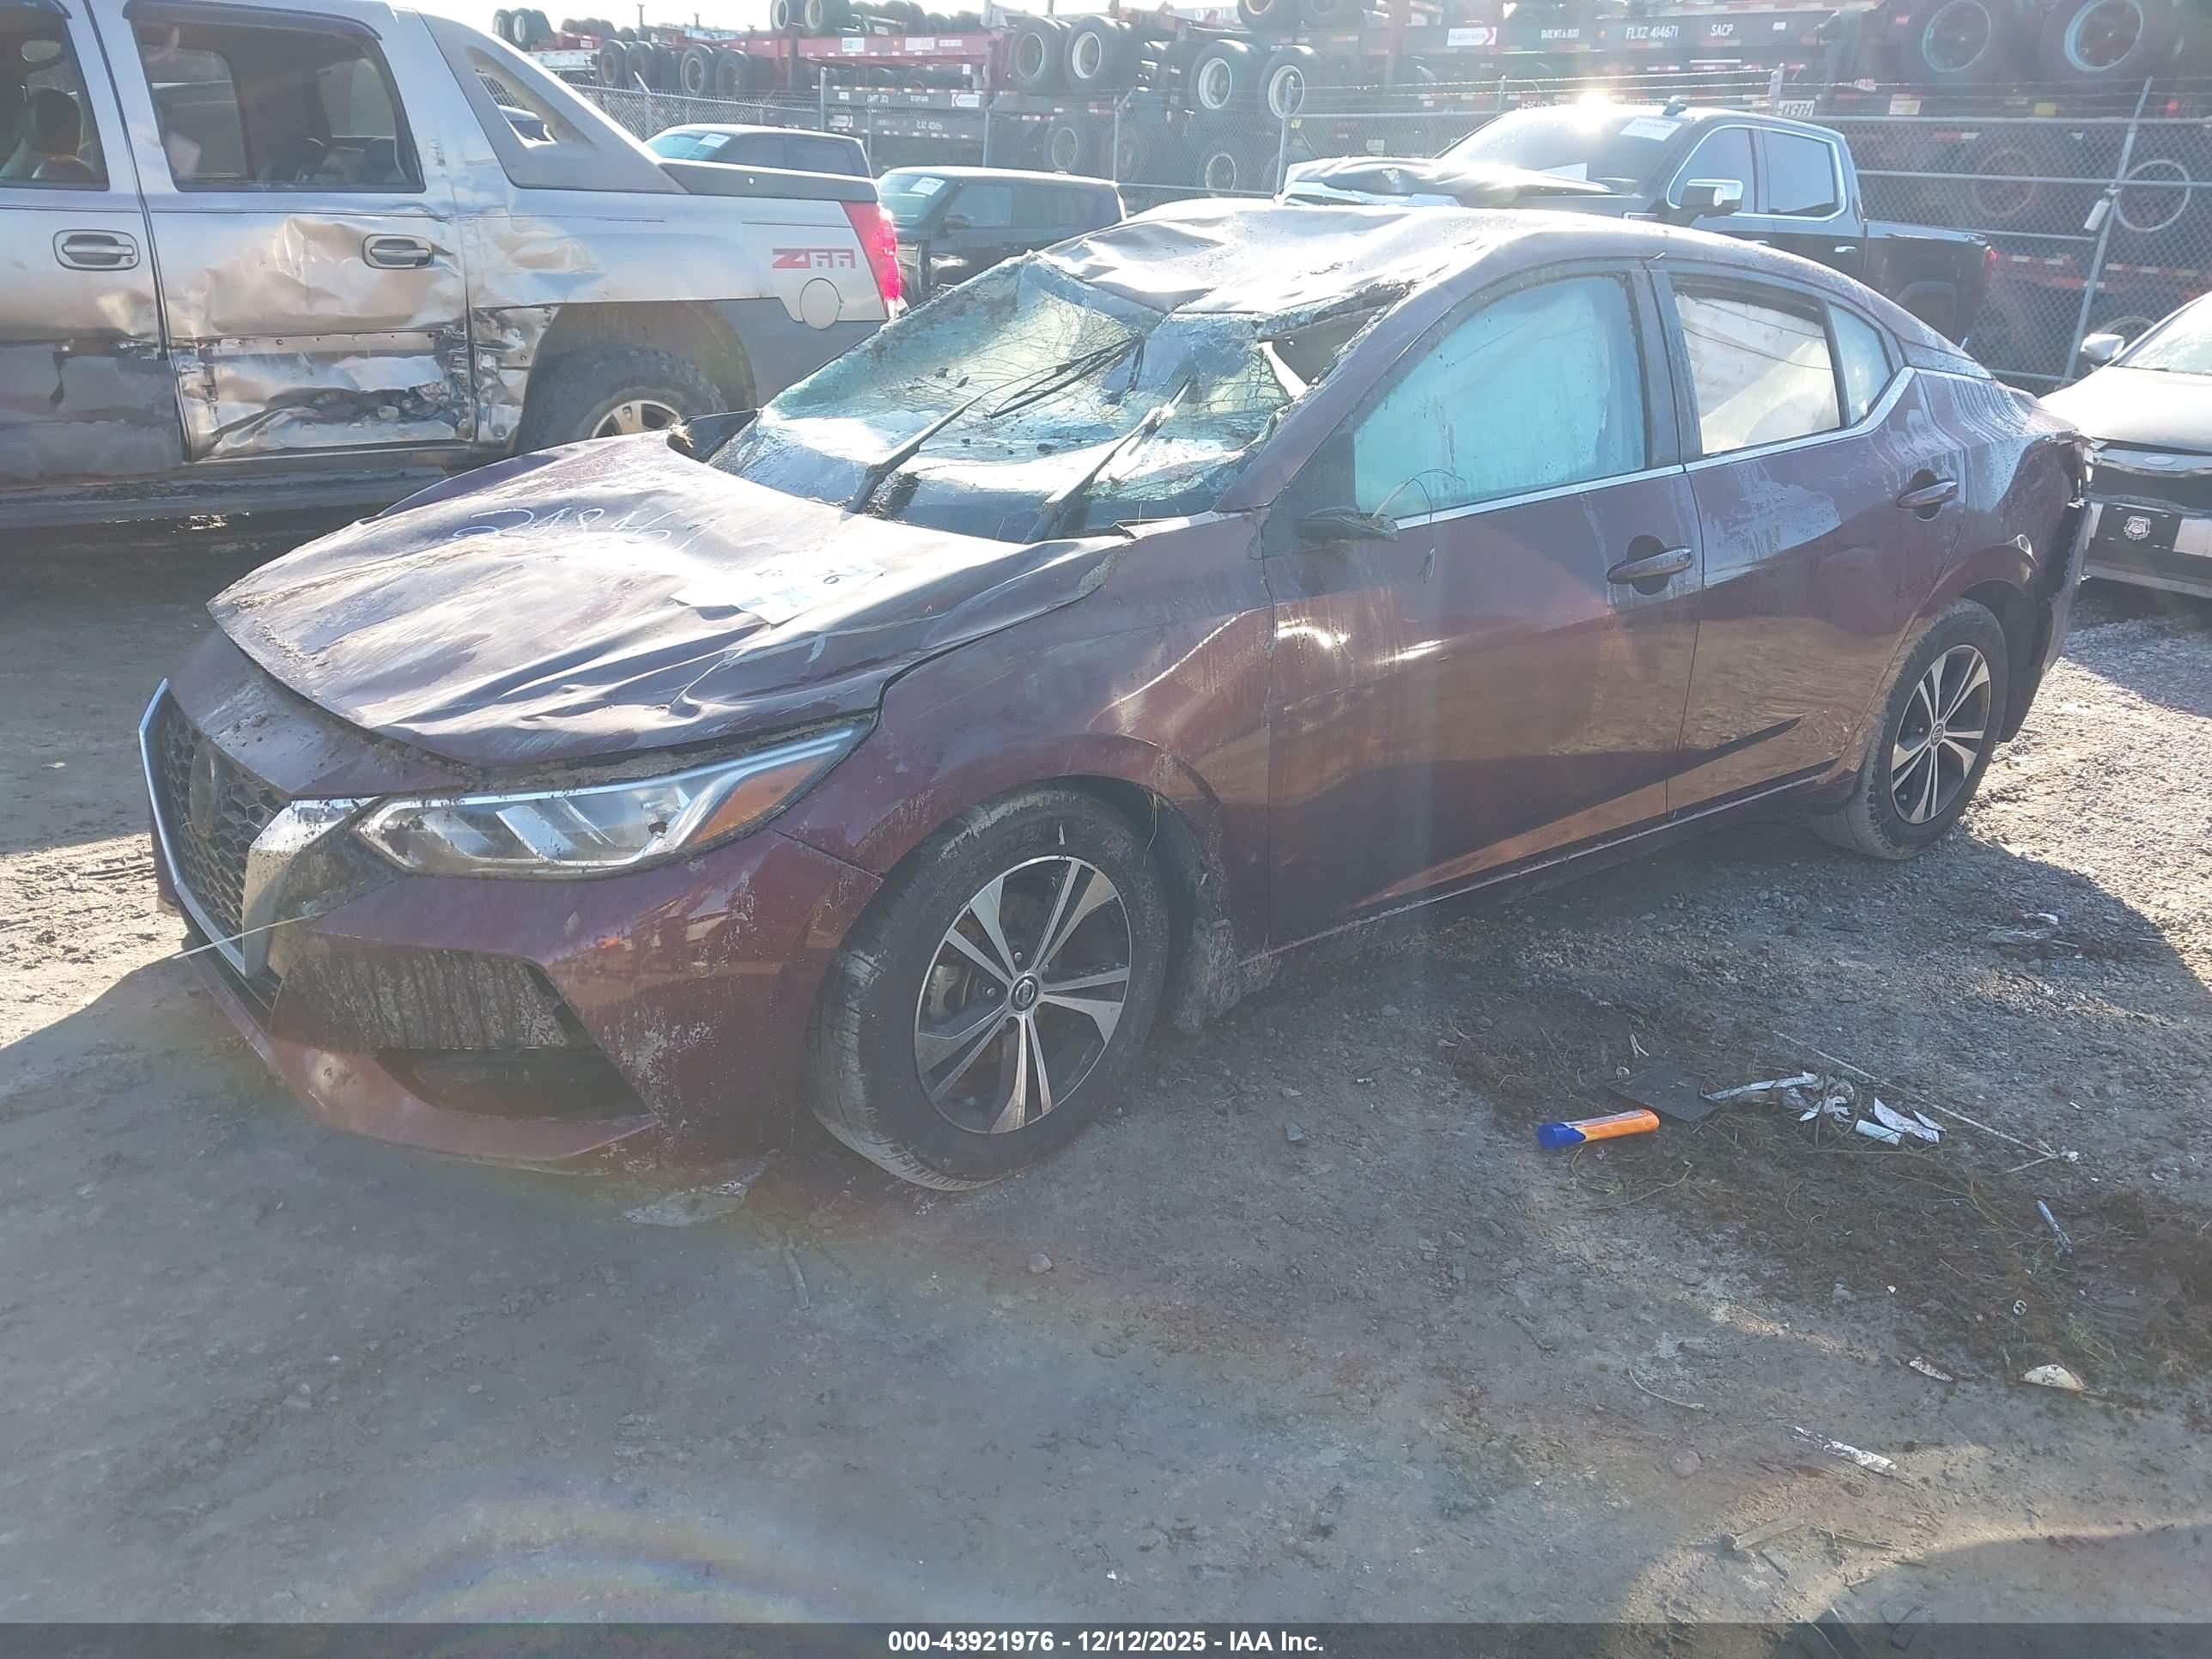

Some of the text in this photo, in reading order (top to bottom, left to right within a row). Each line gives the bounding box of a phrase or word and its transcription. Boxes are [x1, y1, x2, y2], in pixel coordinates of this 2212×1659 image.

[1626, 25, 1679, 40] FLXZ 414671
[1710, 23, 1734, 37] SACP
